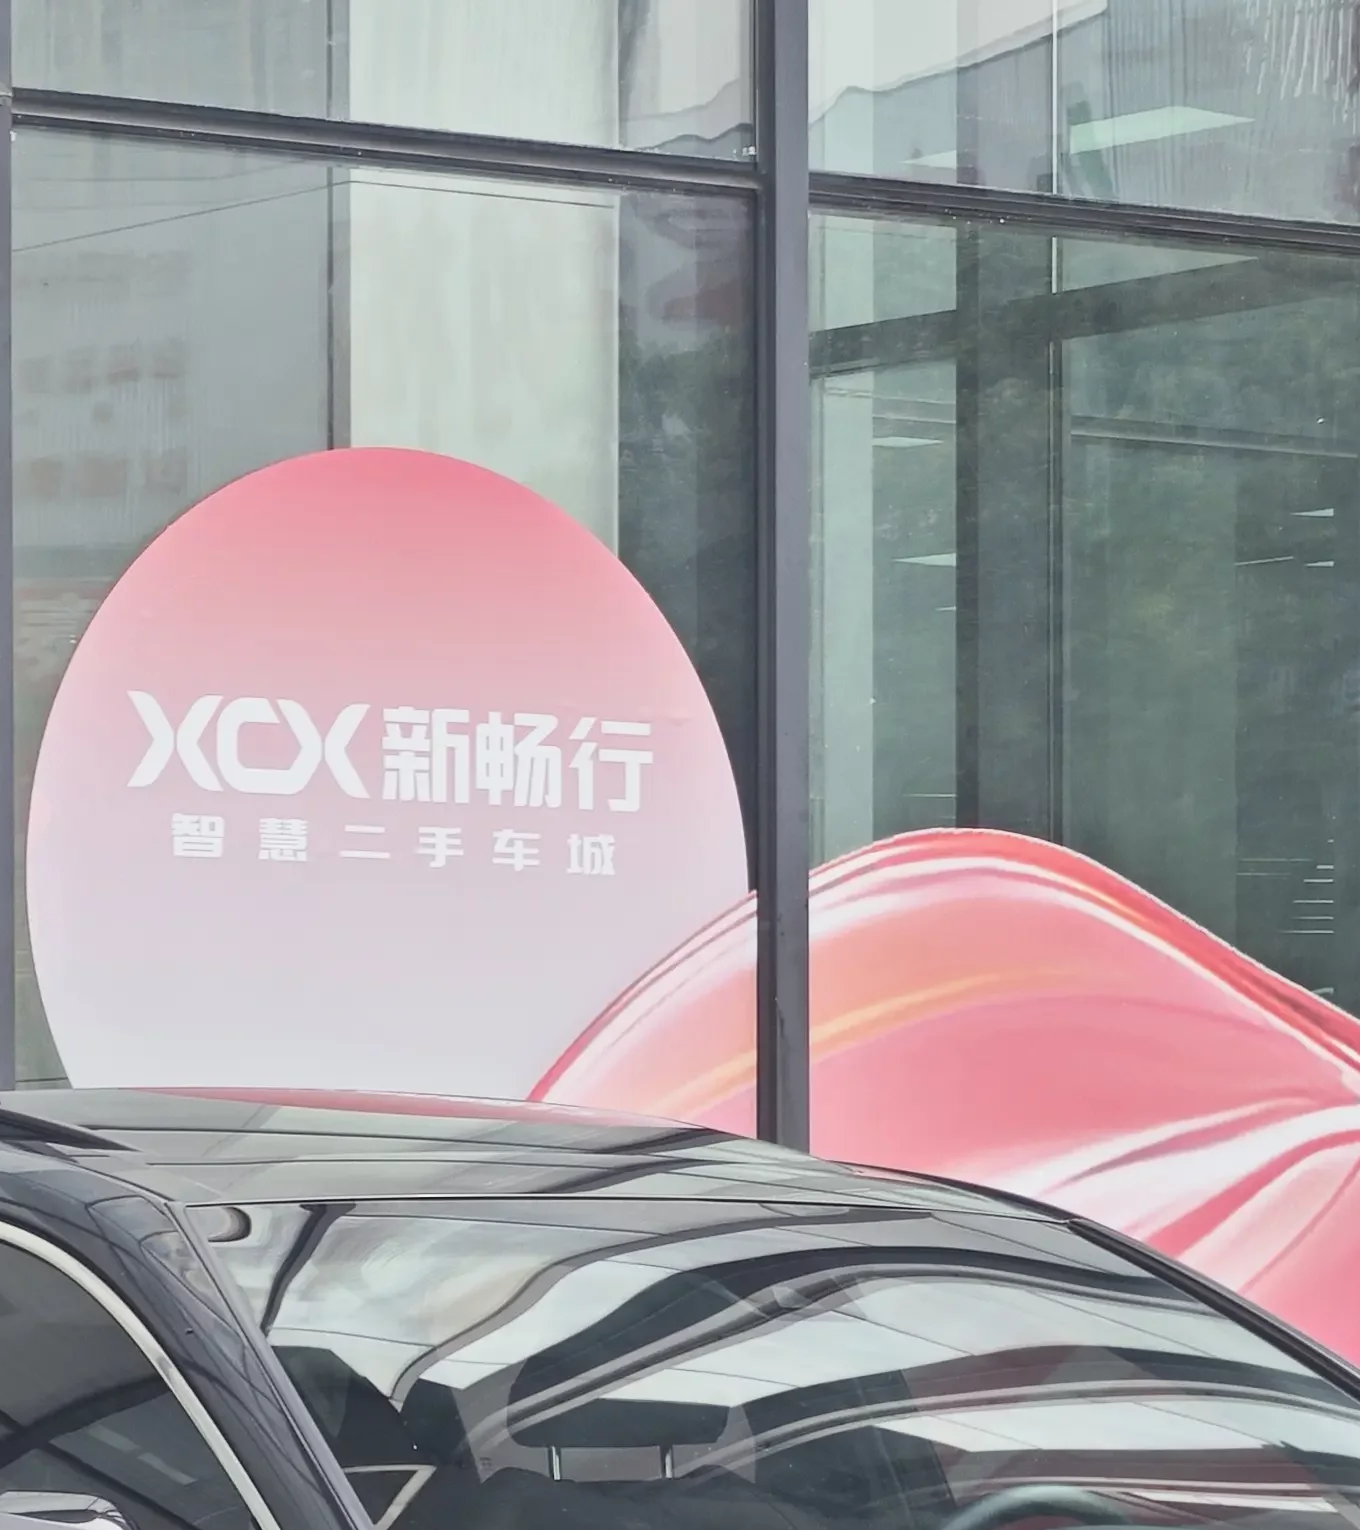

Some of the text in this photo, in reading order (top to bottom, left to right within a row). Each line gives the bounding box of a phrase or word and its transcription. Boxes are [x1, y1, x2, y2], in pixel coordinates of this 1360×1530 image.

[383, 706, 653, 812] 新畅行
[172, 812, 616, 875] 智慧二手车城
